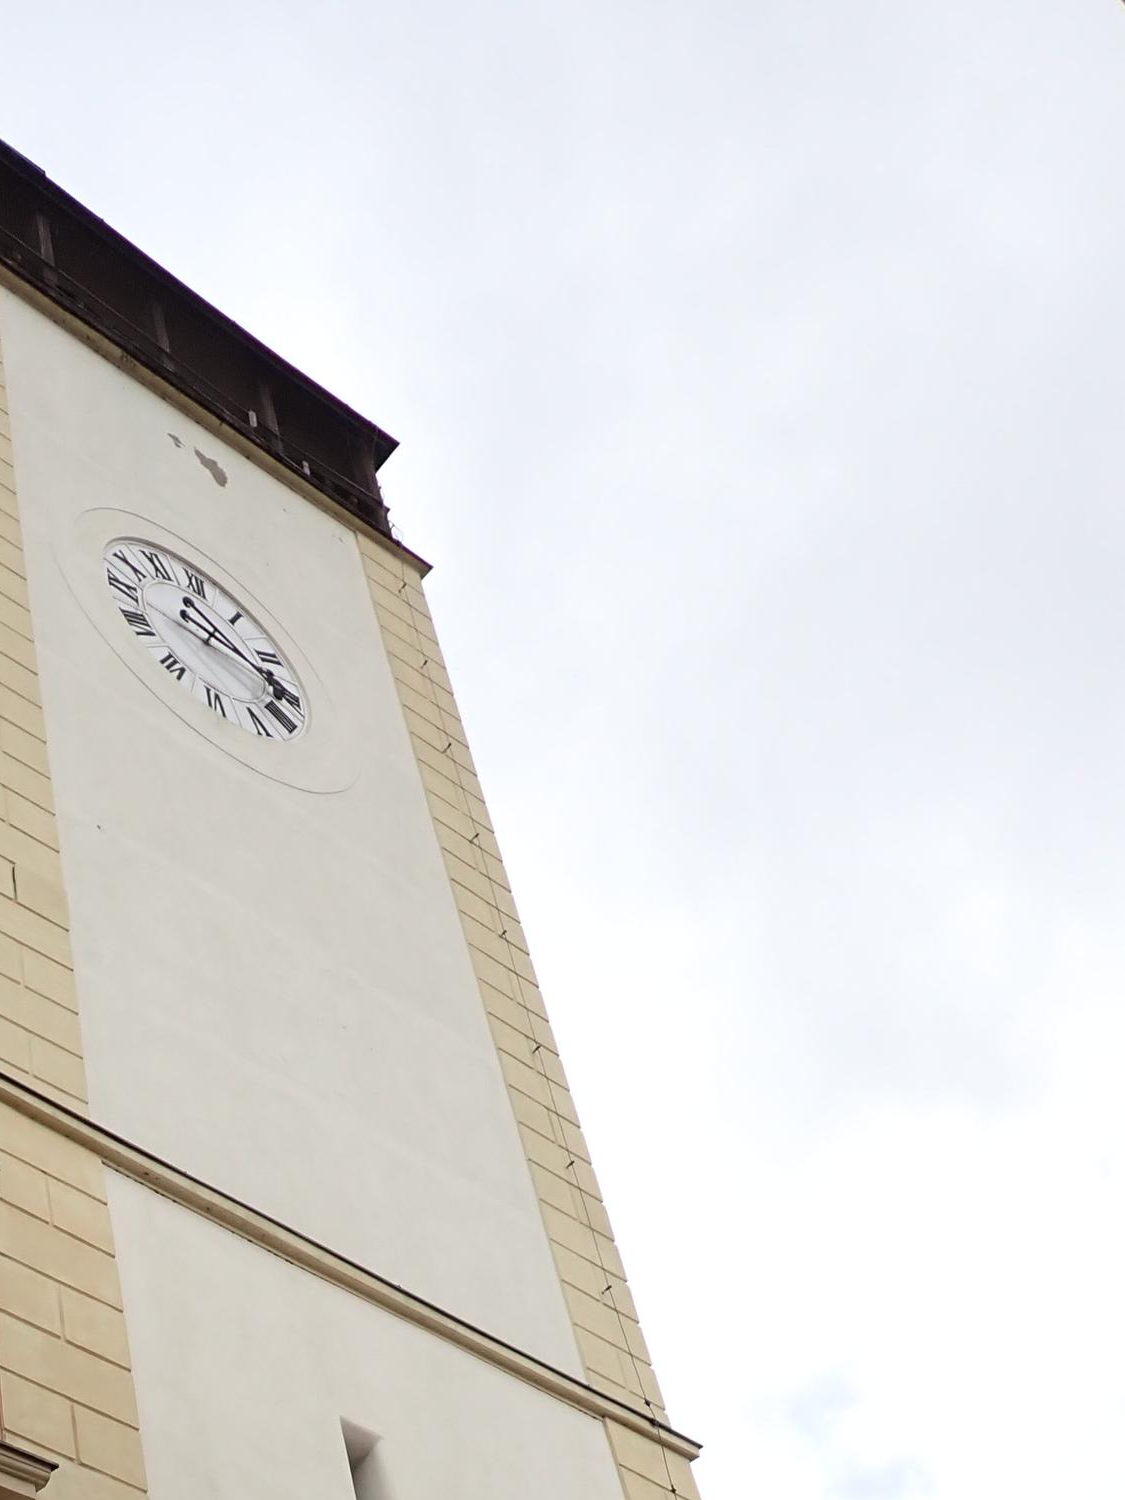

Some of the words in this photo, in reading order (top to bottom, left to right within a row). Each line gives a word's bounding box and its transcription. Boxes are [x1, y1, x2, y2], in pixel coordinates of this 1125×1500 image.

[113, 550, 146, 582] X
[139, 550, 174, 582] XI
[107, 567, 139, 606] IX
[182, 568, 207, 600] XII
[118, 606, 156, 637] VIII
[229, 611, 244, 625] I
[159, 653, 186, 681] VII
[253, 649, 284, 668] II
[204, 685, 227, 719] VI
[246, 706, 274, 738] V
